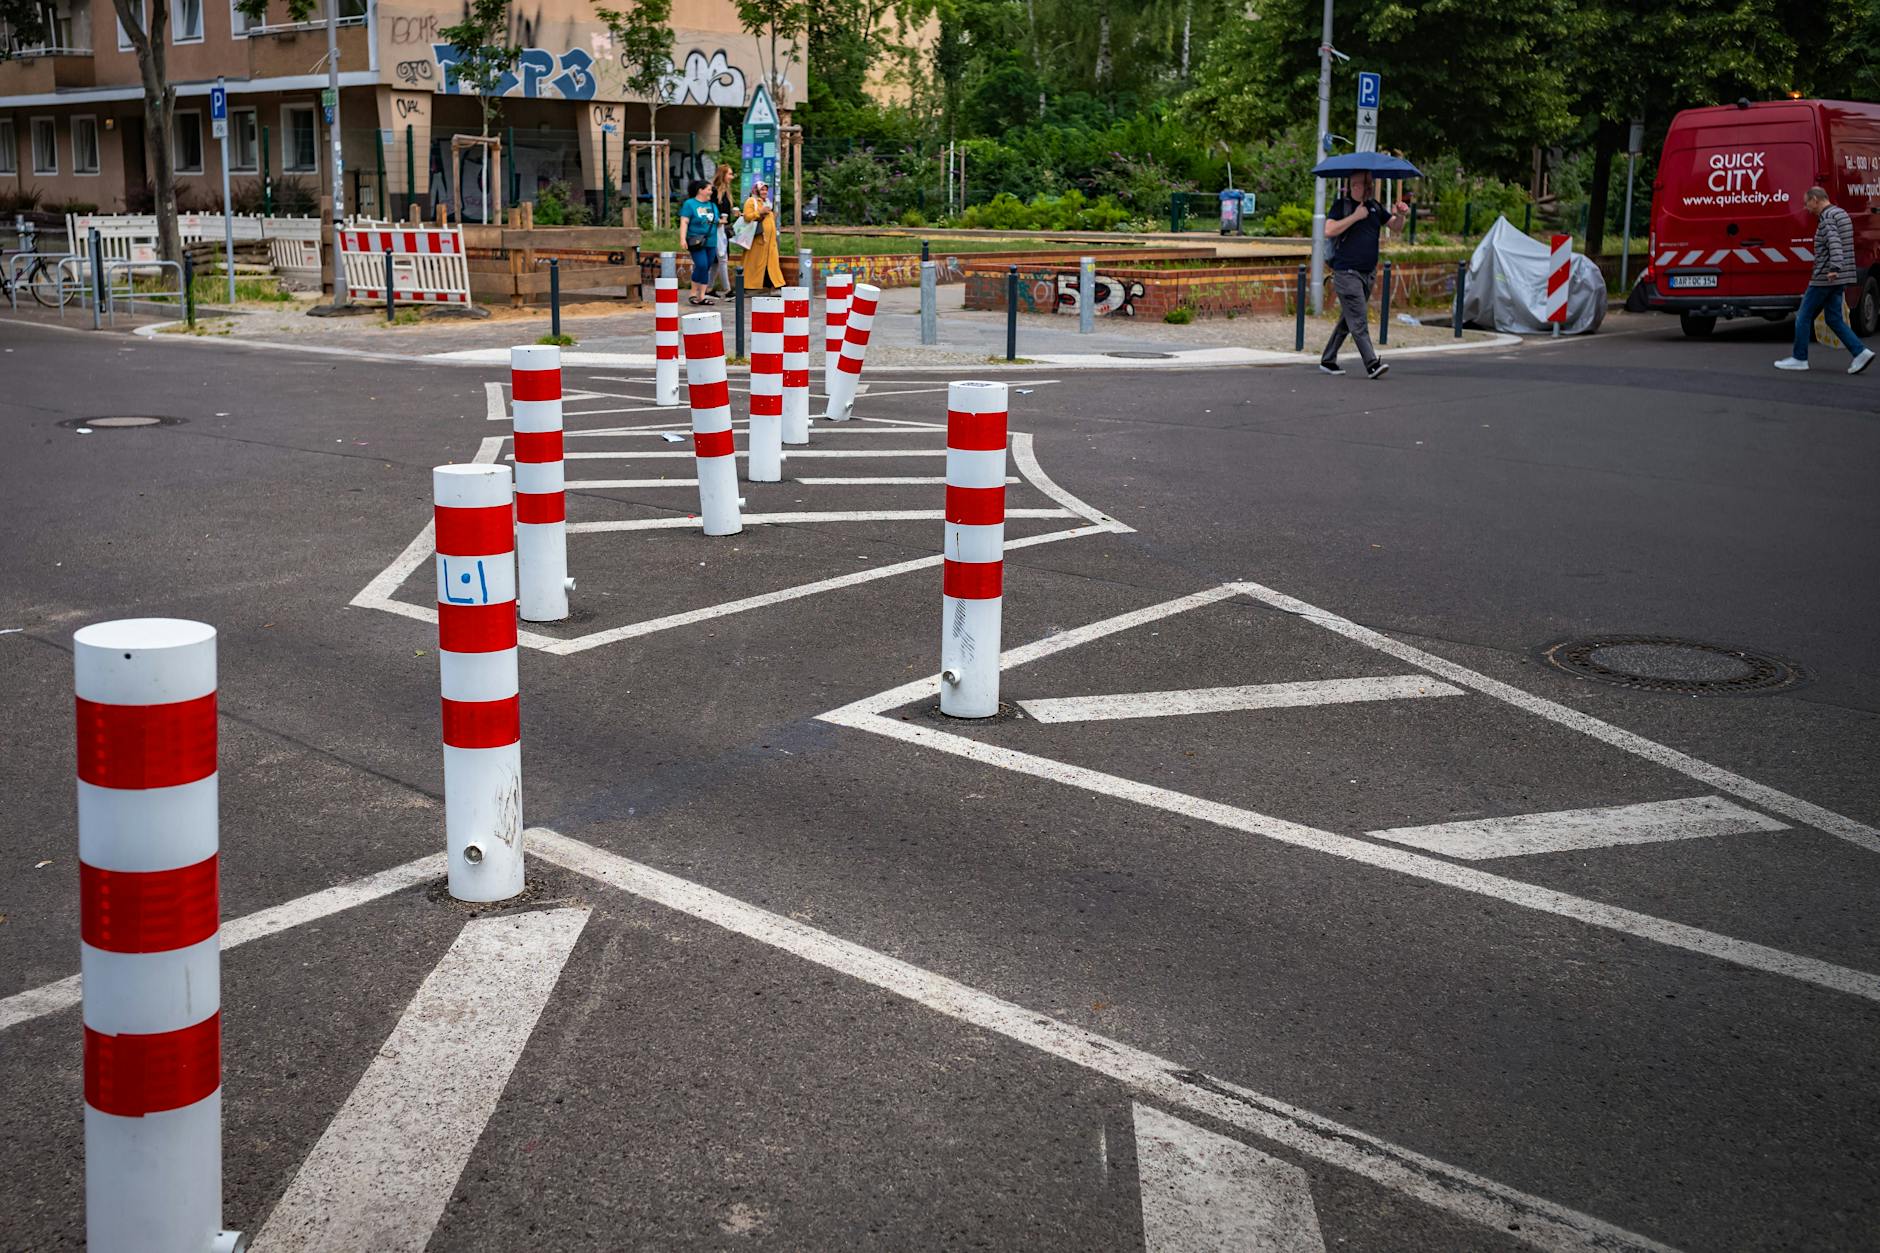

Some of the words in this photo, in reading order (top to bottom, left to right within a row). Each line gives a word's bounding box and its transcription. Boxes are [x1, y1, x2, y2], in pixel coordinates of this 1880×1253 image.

[1361, 77, 1374, 104] P
[213, 91, 223, 116] P
[1709, 151, 1765, 169] QUICK
[1707, 168, 1764, 192] CITY
[1682, 188, 1789, 208] www.quickcity.de
